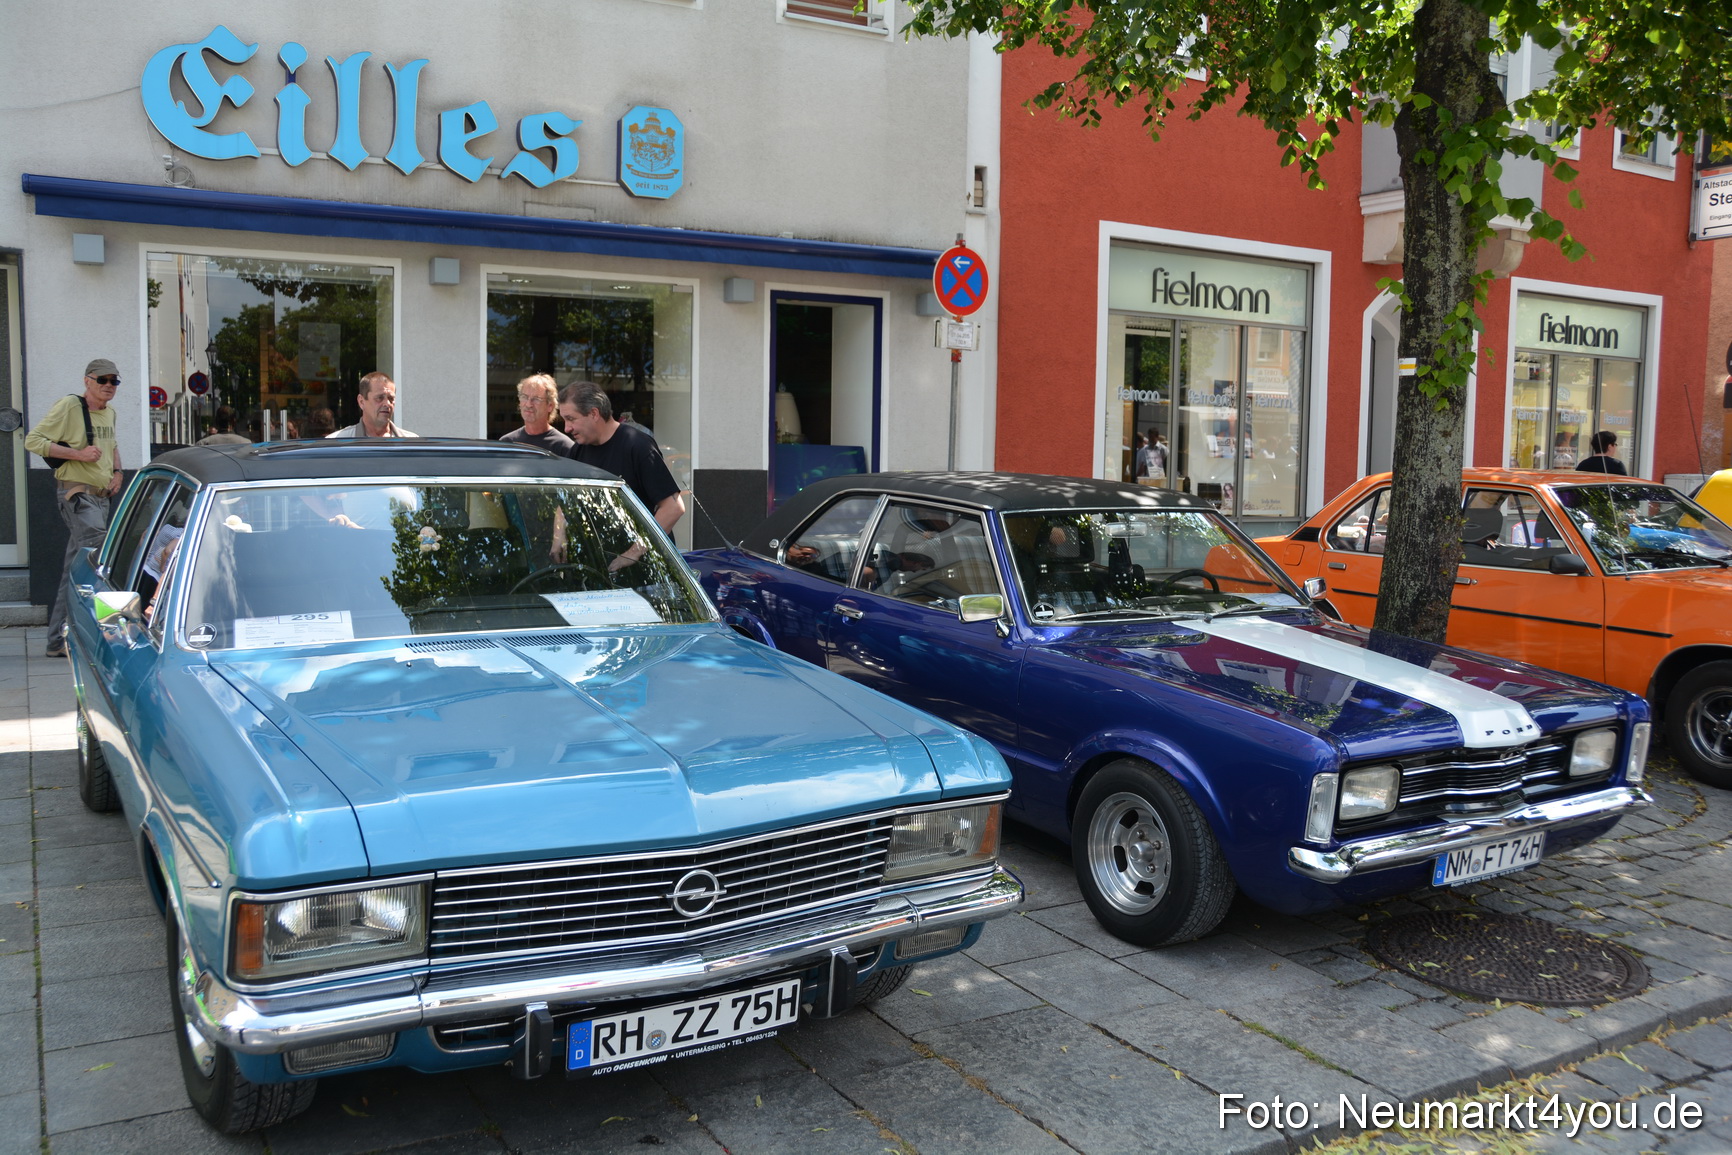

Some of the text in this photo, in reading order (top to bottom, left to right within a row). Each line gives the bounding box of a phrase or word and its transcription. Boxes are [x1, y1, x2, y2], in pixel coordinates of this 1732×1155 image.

[140, 24, 583, 188] Eilles
[653, 183, 669, 191] 1873
[1709, 212, 1732, 221] Eingang
[1485, 724, 1533, 736] FORD
[1446, 849, 1473, 878] NM
[1482, 842, 1508, 871] FT
[1510, 834, 1543, 864] 74H
[1436, 870, 1442, 879] D
[593, 984, 798, 1060] RH ZZ 75H
[574, 1049, 584, 1061] D
[592, 1066, 613, 1077] AUTO
[675, 1041, 726, 1059] UNTERMÄSSING
[731, 1038, 745, 1047] TEL.
